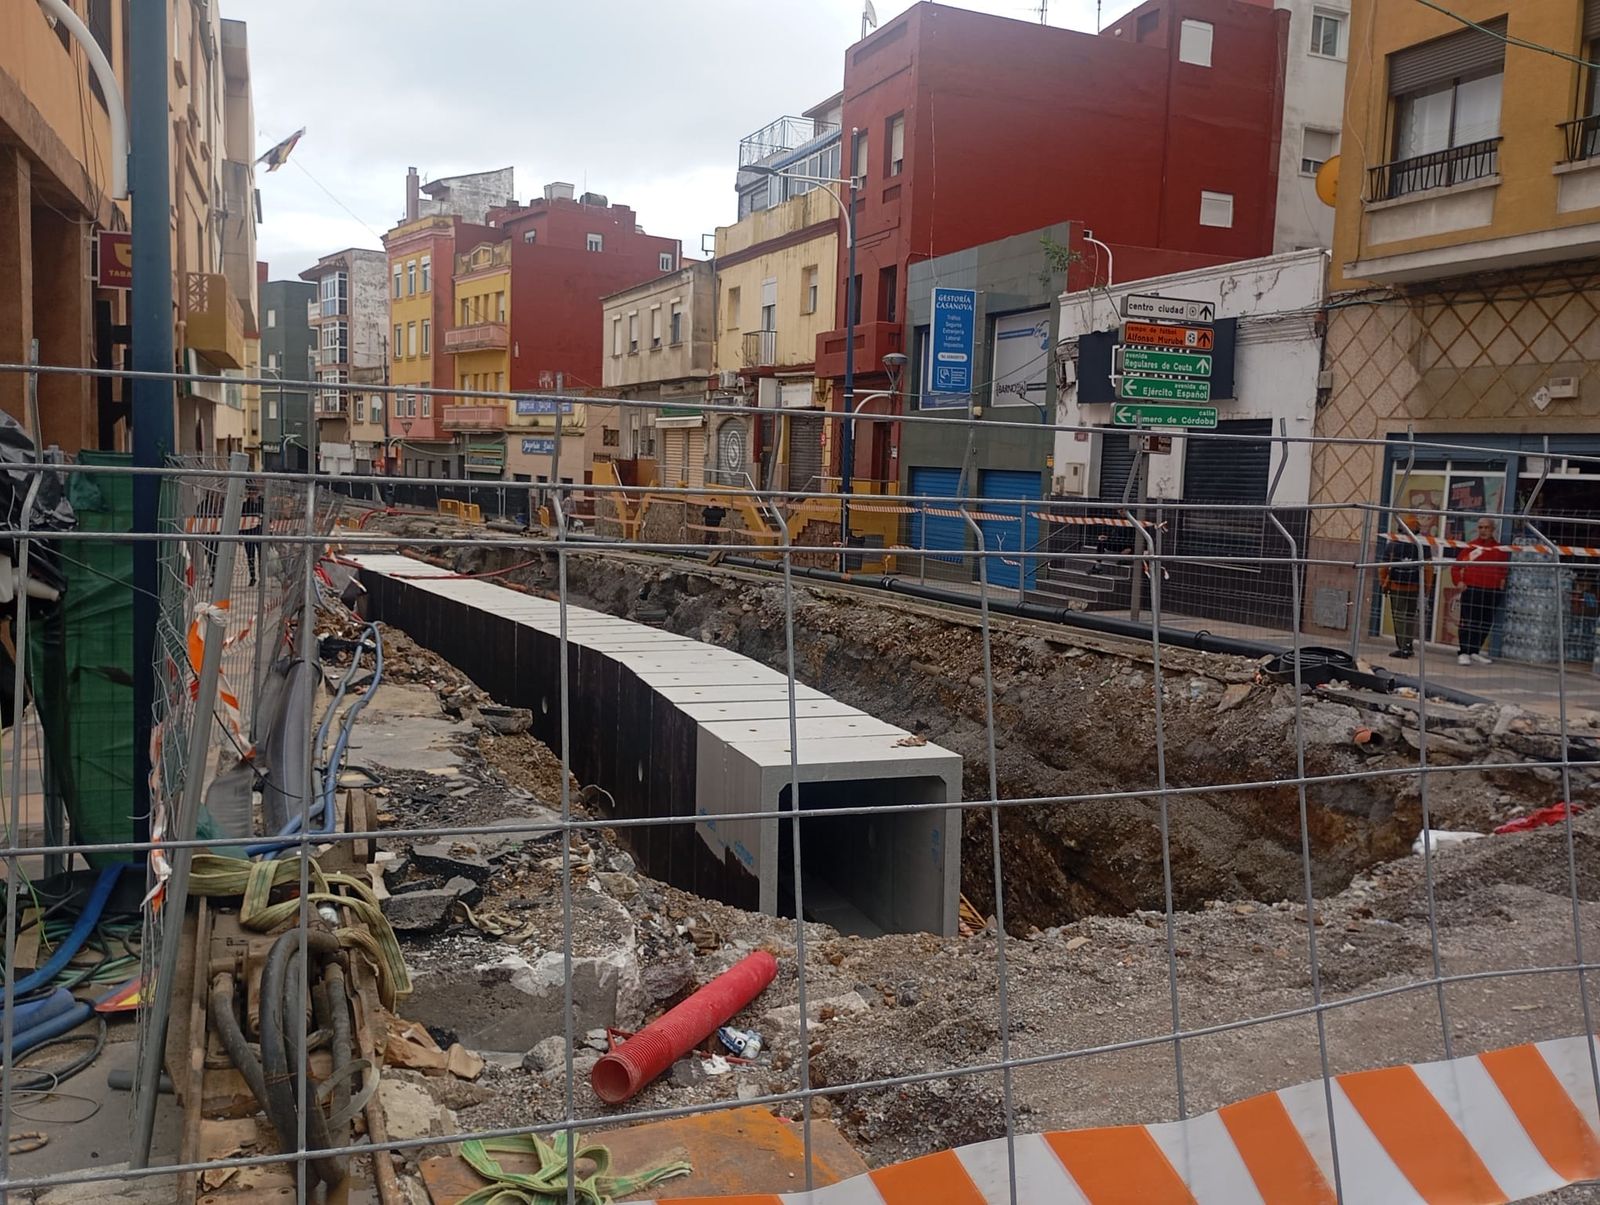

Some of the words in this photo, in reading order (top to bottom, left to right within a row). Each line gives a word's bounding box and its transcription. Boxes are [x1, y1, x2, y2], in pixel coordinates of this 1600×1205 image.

[108, 269, 132, 278] TABA
[938, 294, 971, 303] GESTORÍA
[936, 301, 973, 312] CASANOVA
[1128, 303, 1154, 312] centro
[1158, 304, 1185, 315] ciudad
[1127, 333, 1154, 344] Alfonso
[1158, 337, 1184, 346] Murube
[1125, 359, 1158, 370] Regulares
[1161, 361, 1170, 370] de
[1173, 362, 1193, 372] Ceuta
[1142, 386, 1173, 397] Ejército
[1176, 389, 1207, 399] Español
[1131, 414, 1163, 424] Rmero
[1167, 416, 1177, 424] de
[1181, 416, 1215, 426] Córdoba
